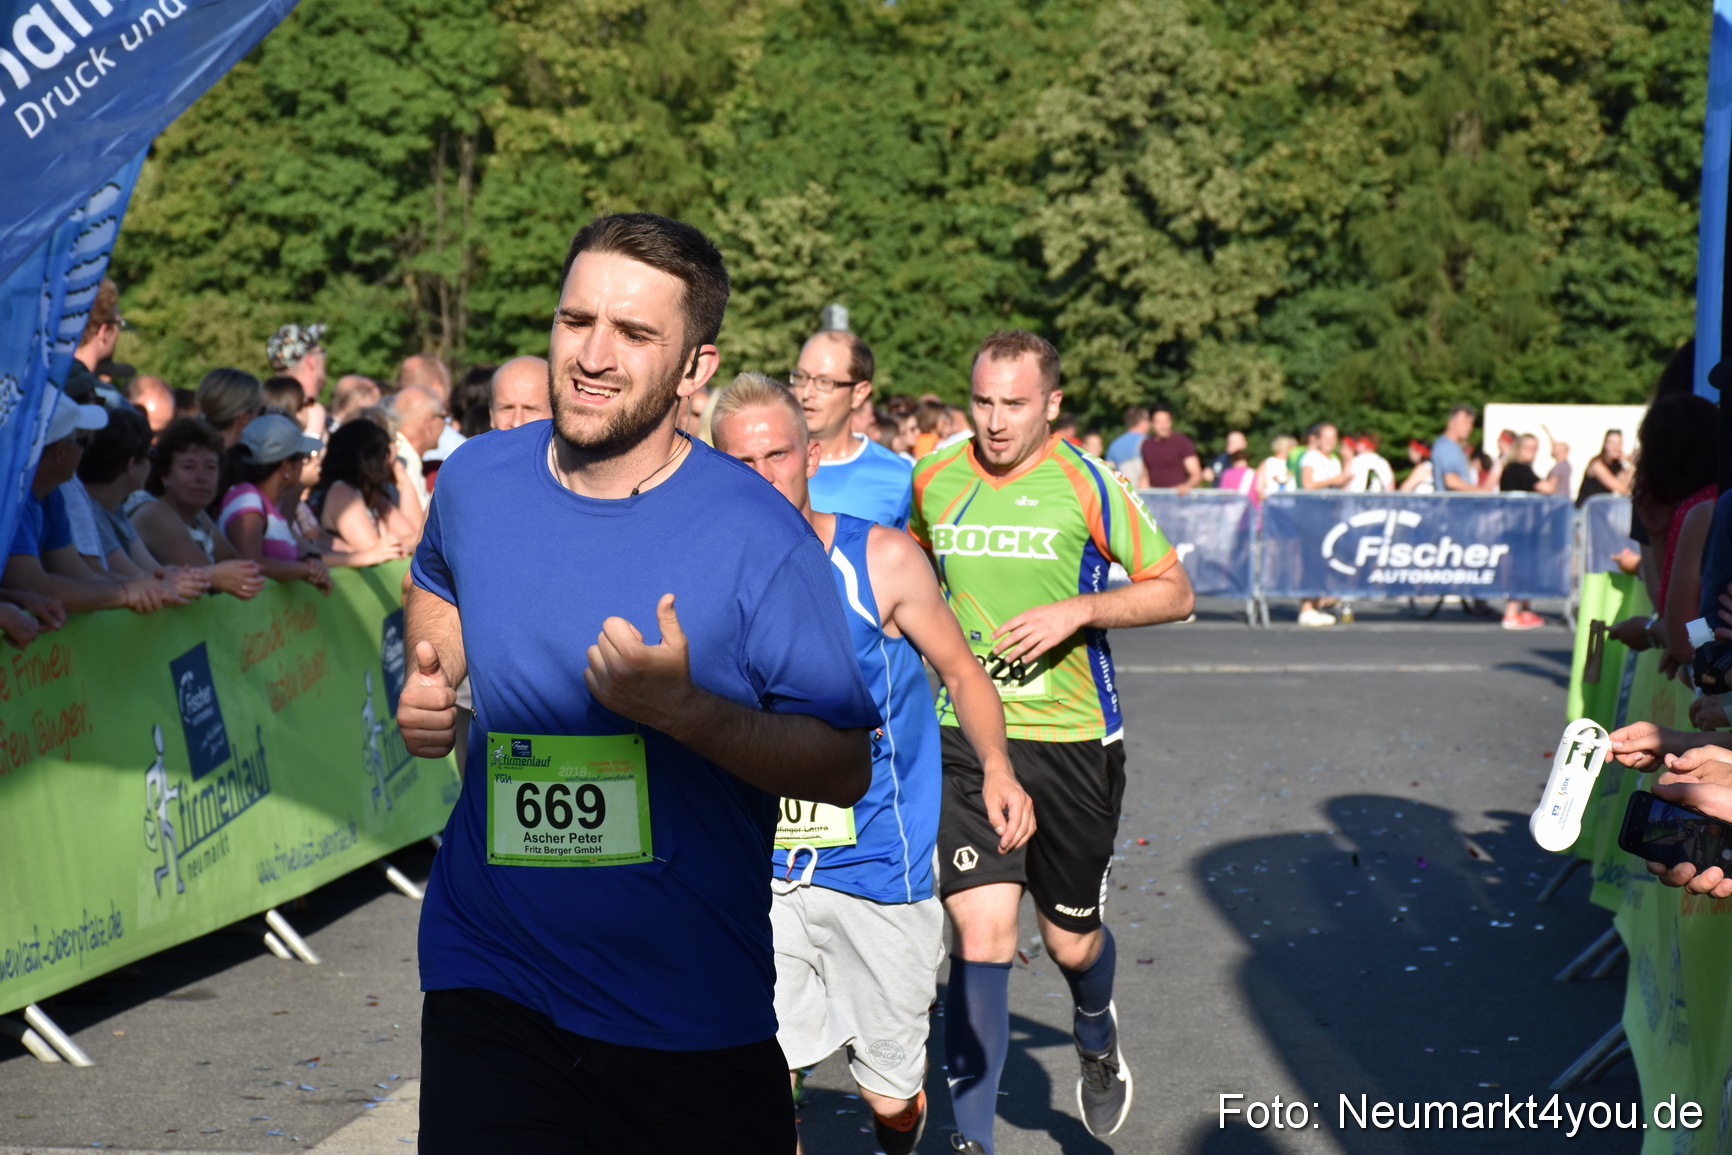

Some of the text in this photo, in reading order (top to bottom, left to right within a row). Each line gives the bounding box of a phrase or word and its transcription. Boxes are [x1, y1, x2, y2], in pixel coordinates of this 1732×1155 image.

[14, 47, 117, 139] Druck
[932, 524, 1060, 560] BOCK
[1357, 534, 1509, 568] Fischer
[1369, 569, 1495, 585] AUTOMOBILE
[503, 754, 551, 767] firmenlauf
[558, 767, 588, 777] 2018
[178, 724, 270, 851] firmenlauf
[1561, 777, 1571, 792] SDK
[516, 782, 606, 830] 669
[523, 832, 603, 844] Ascher Peter
[187, 830, 231, 881] neumarkt
[524, 846, 603, 857] Fritz Berger GmbH
